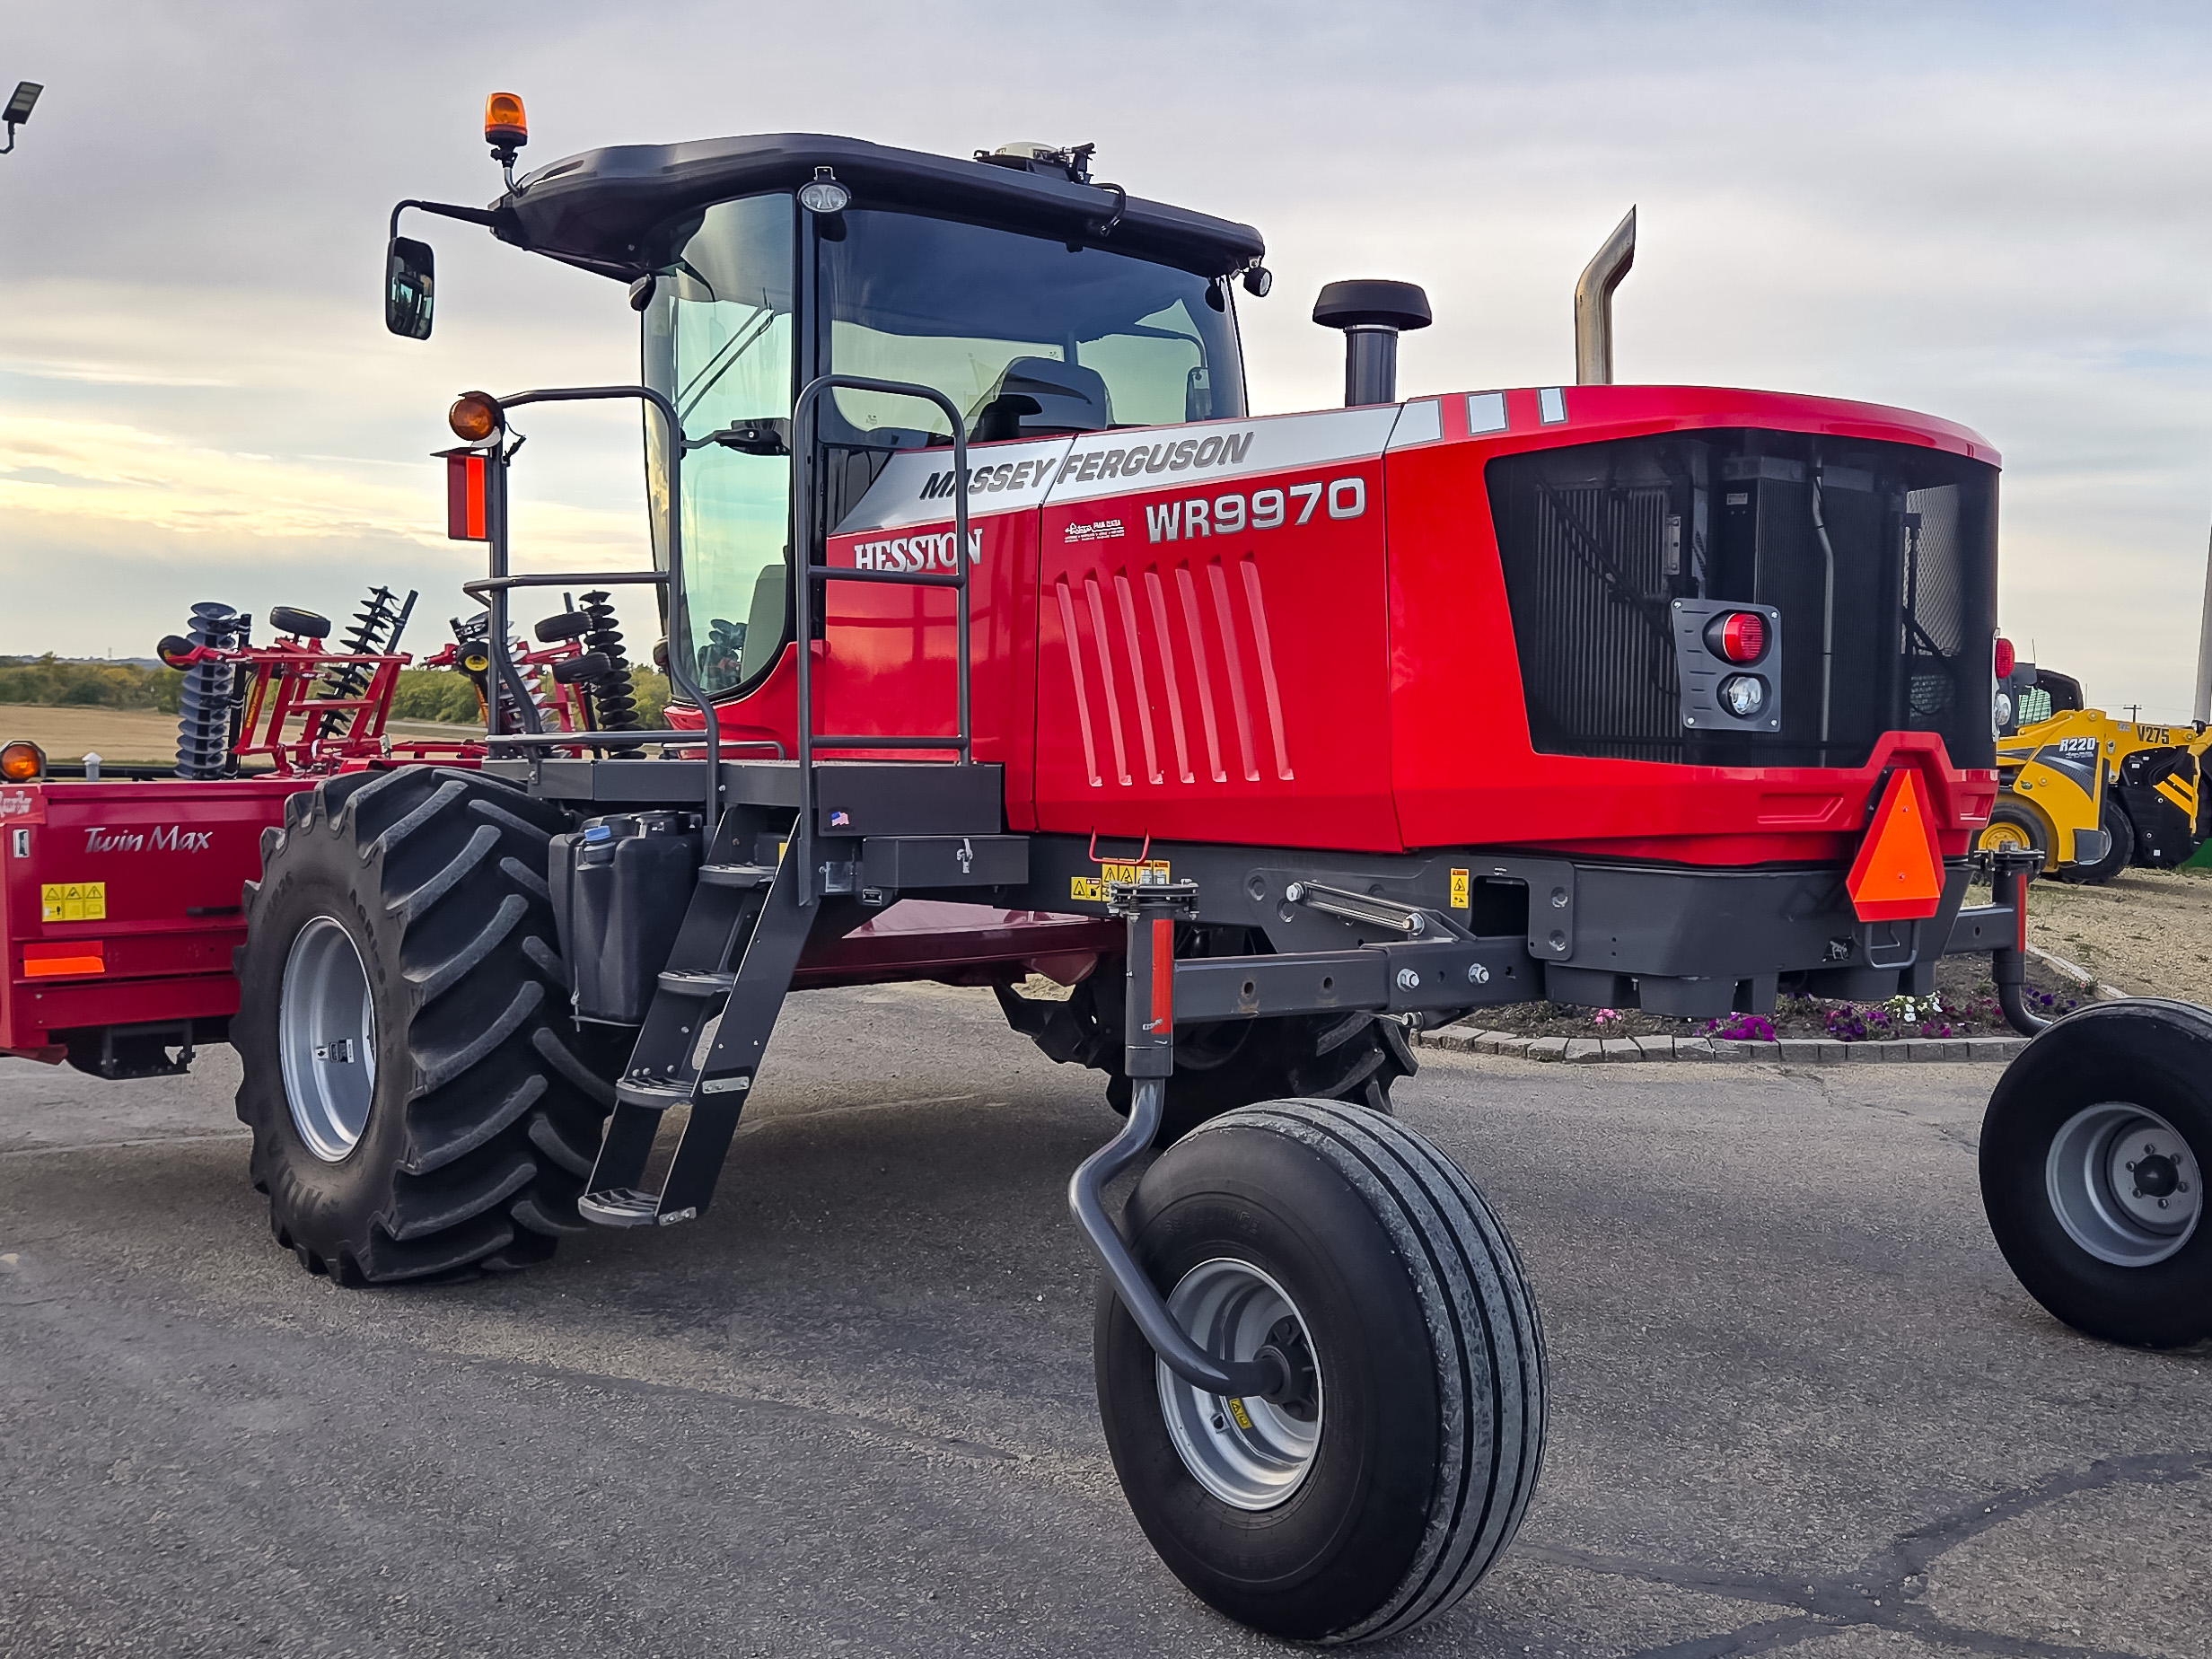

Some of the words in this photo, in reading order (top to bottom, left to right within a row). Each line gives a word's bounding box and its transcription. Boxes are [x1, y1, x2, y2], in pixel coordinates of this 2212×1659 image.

[1058, 433, 1254, 484] FERGUSON
[1146, 476, 1367, 544] WR9970
[854, 528, 984, 573] HESSTON
[2059, 737, 2095, 751] R220
[2137, 725, 2170, 744] V275
[84, 827, 144, 853] Twin
[146, 825, 213, 854] Max
